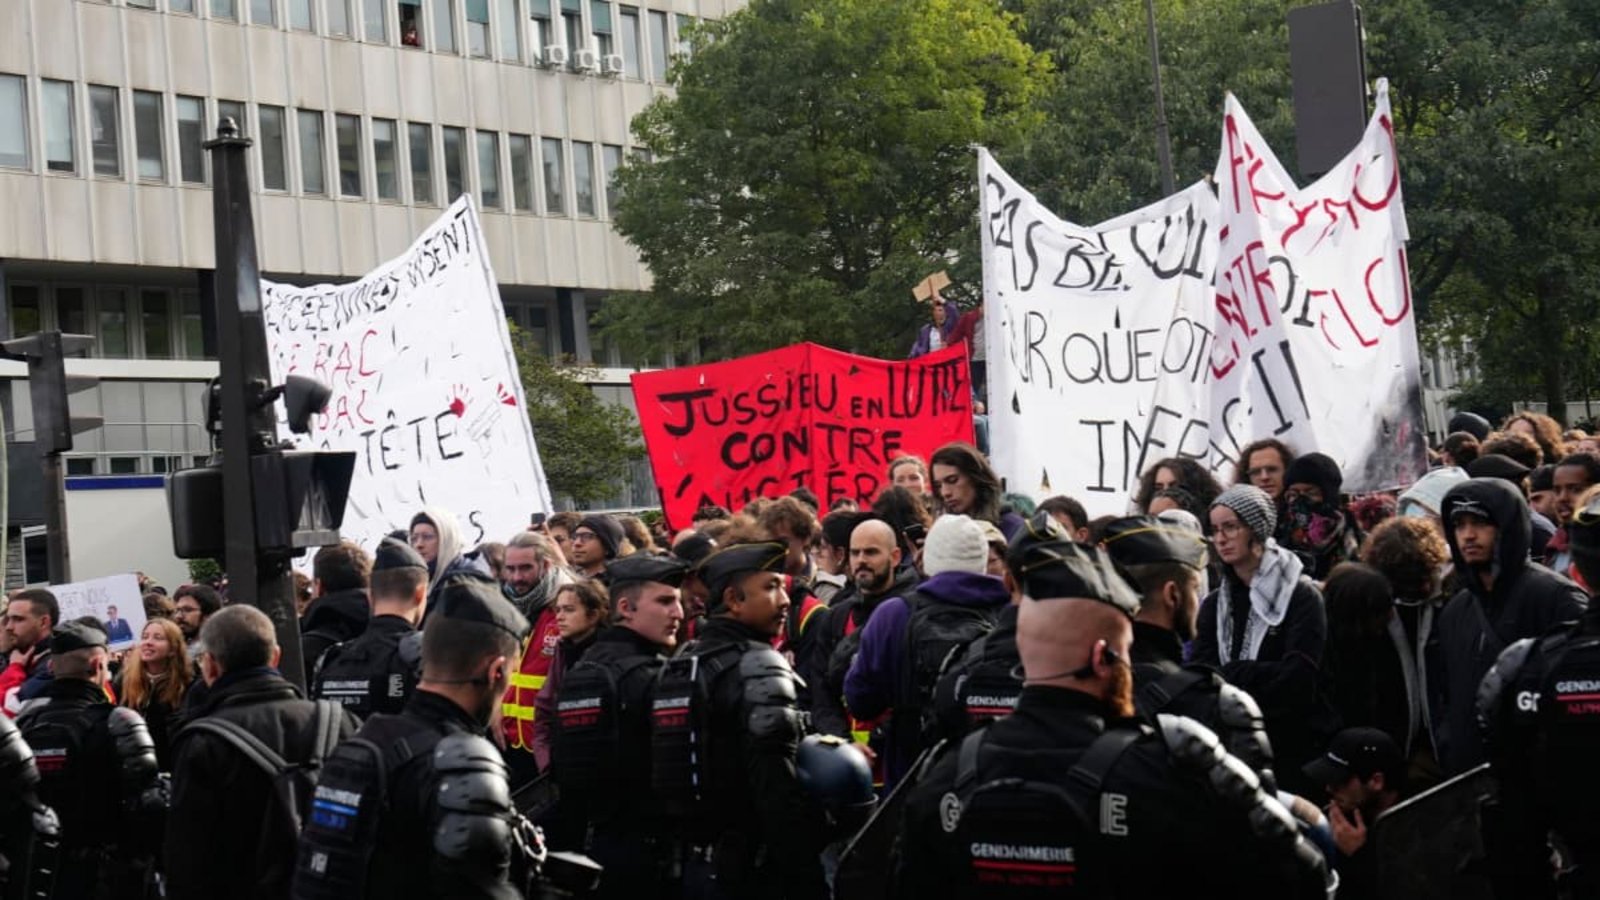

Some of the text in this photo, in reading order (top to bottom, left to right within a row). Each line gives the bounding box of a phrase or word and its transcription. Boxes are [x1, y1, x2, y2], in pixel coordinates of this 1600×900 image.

[1062, 329, 1161, 384] QUE
[851, 396, 884, 419] EN
[361, 408, 465, 476] TÊTE
[721, 420, 902, 471] CONTRE
[970, 842, 1075, 863] GENDARMERIE
